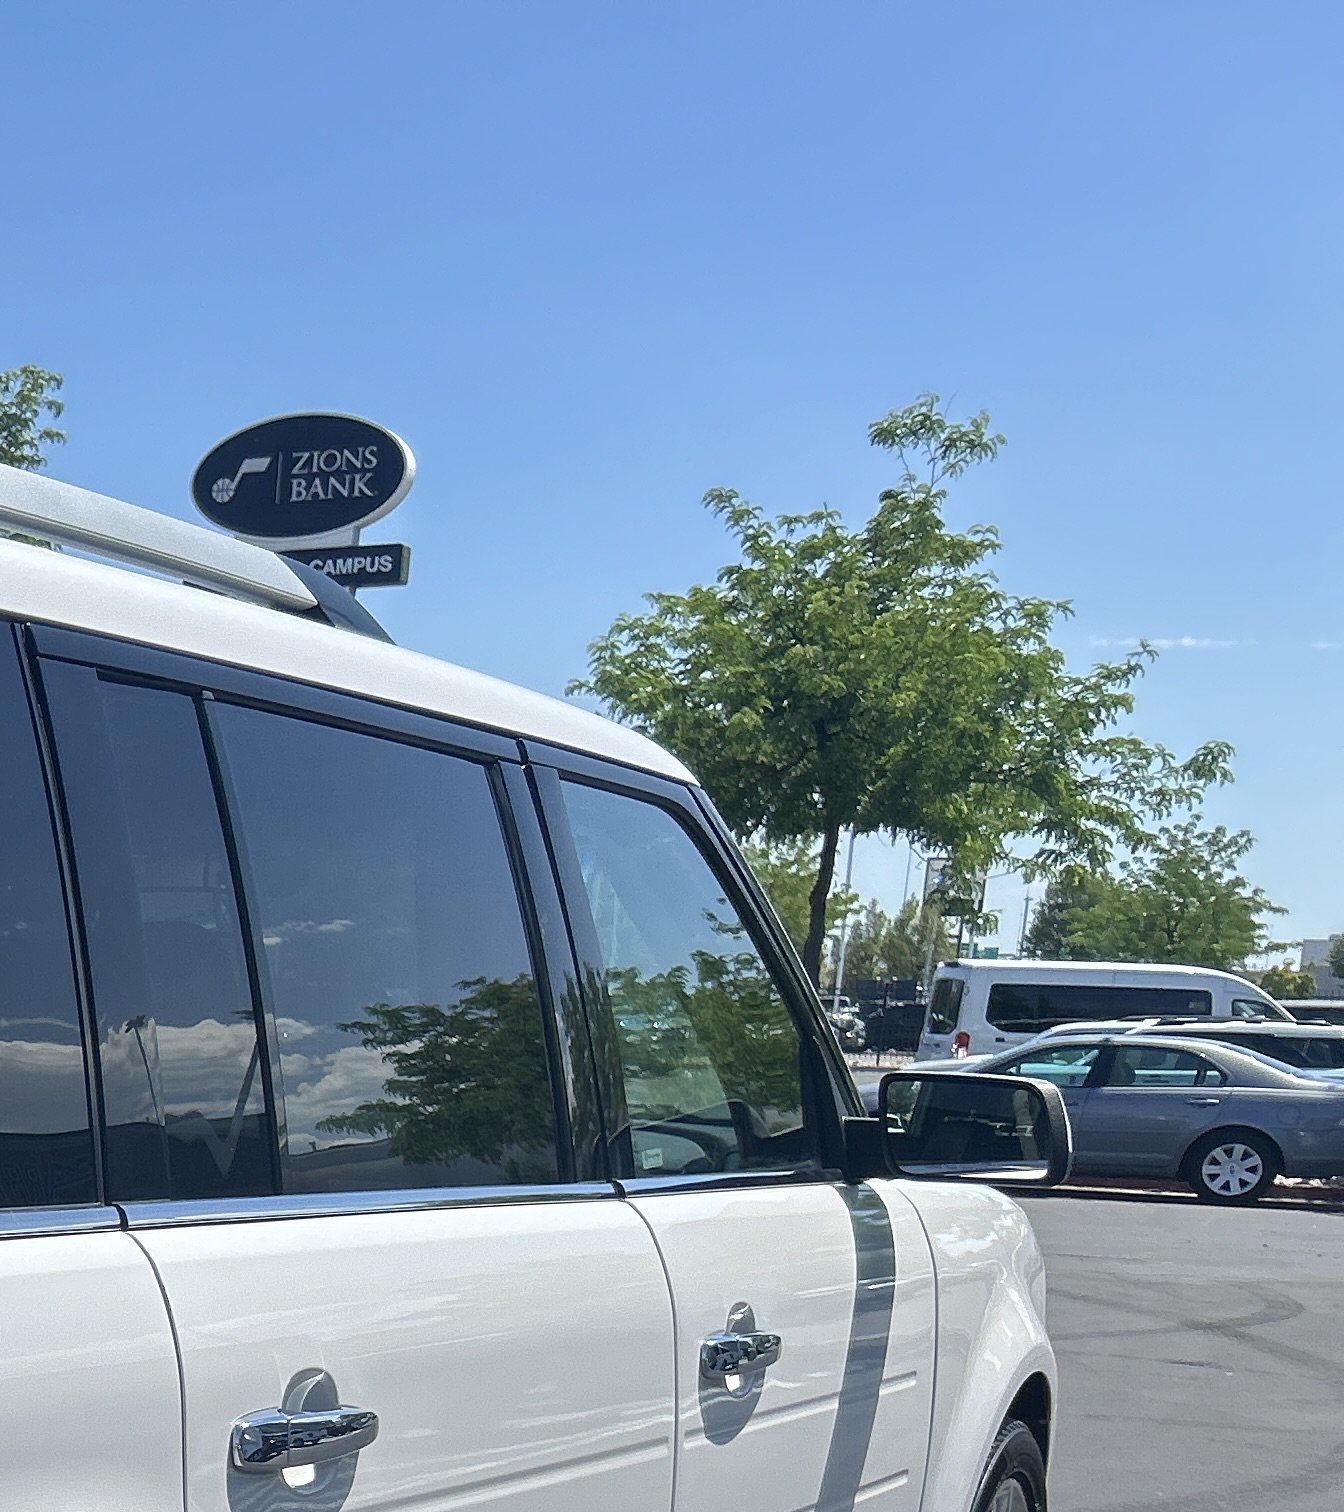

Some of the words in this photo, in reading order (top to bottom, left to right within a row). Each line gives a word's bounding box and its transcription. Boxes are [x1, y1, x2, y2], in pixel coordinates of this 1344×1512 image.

[291, 446, 378, 475] ZIONS
[290, 473, 374, 502] BANK
[311, 554, 393, 575] CAMPUS
